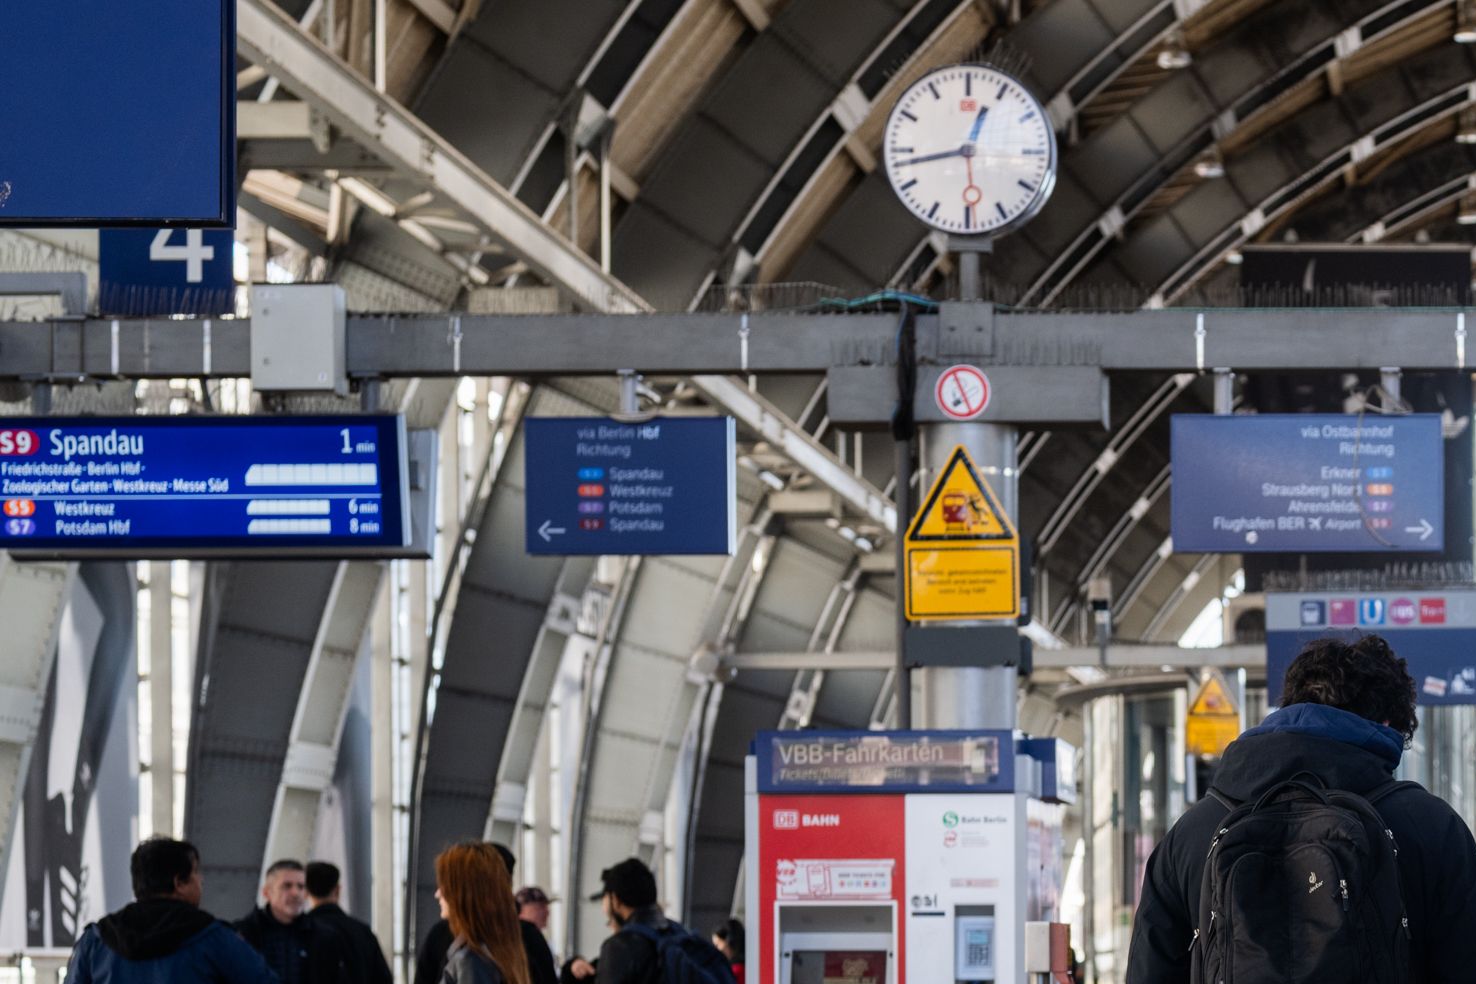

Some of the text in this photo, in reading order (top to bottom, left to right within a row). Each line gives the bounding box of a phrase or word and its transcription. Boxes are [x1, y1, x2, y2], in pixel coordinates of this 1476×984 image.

[150, 228, 214, 282] 4
[577, 426, 660, 439] via Berlin Hbf
[1301, 426, 1319, 438] via
[0, 431, 32, 453] S9
[50, 429, 144, 461] Spandau
[340, 428, 375, 453] 1 min
[577, 444, 631, 457] Richtung
[1, 460, 141, 476] Friedrichstraße Berlin Hbf
[609, 467, 664, 481] Spandau
[1321, 466, 1361, 479] Erkner
[2, 477, 229, 496] Zoologischer Garten Westkreuz Messe Süd
[609, 484, 673, 497] Westkreuz
[1262, 483, 1329, 498] Strausberg
[54, 501, 115, 516] Westkreuz
[348, 499, 378, 514] 6 min
[609, 501, 662, 514] Potsdam
[10, 520, 31, 534] S7
[55, 519, 131, 535] Potsdam Hbf
[350, 518, 379, 533] 8 min
[609, 518, 664, 532] Spandau
[1213, 517, 1275, 532] Flughafen
[1278, 517, 1305, 530] BER
[1325, 518, 1361, 532] Airport
[1362, 600, 1382, 624] U
[779, 741, 944, 765] VBB-Fahrkarten
[774, 811, 840, 828] DB BAHN
